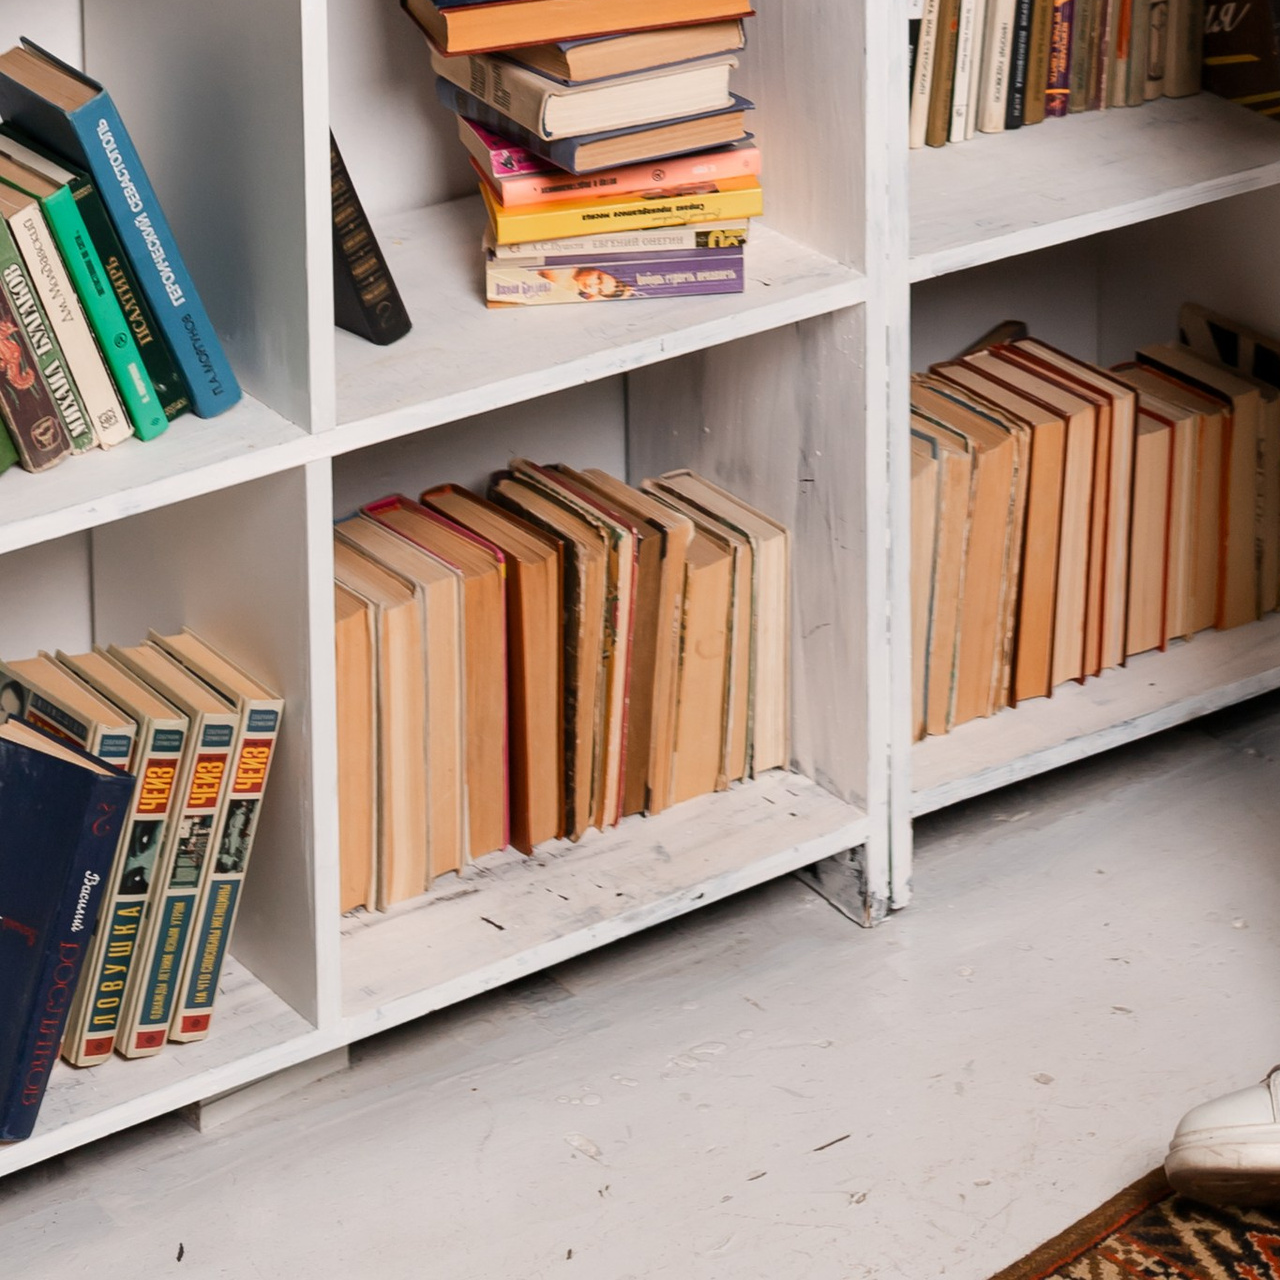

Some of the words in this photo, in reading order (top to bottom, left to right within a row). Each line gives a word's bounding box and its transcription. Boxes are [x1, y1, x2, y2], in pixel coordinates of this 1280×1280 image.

[96, 117, 145, 214] СЕВАСТОПОЛЬ
[107, 255, 154, 347] ПСАЛТИРЬ
[137, 210, 186, 307] ГЕРОИЧЕСКИЙ
[2, 263, 53, 360] БУЛГАКОВ
[42, 358, 89, 439] МИХАИЛ
[139, 766, 174, 811] ЧЕЙЗ
[189, 760, 224, 806] ЧЕЙЗ
[236, 746, 271, 791] ЧЕЙЗ
[71, 870, 101, 932] Василий
[92, 905, 141, 1026] ЛОВУШКА
[20, 941, 81, 1107] РОСЛЯКОВ
